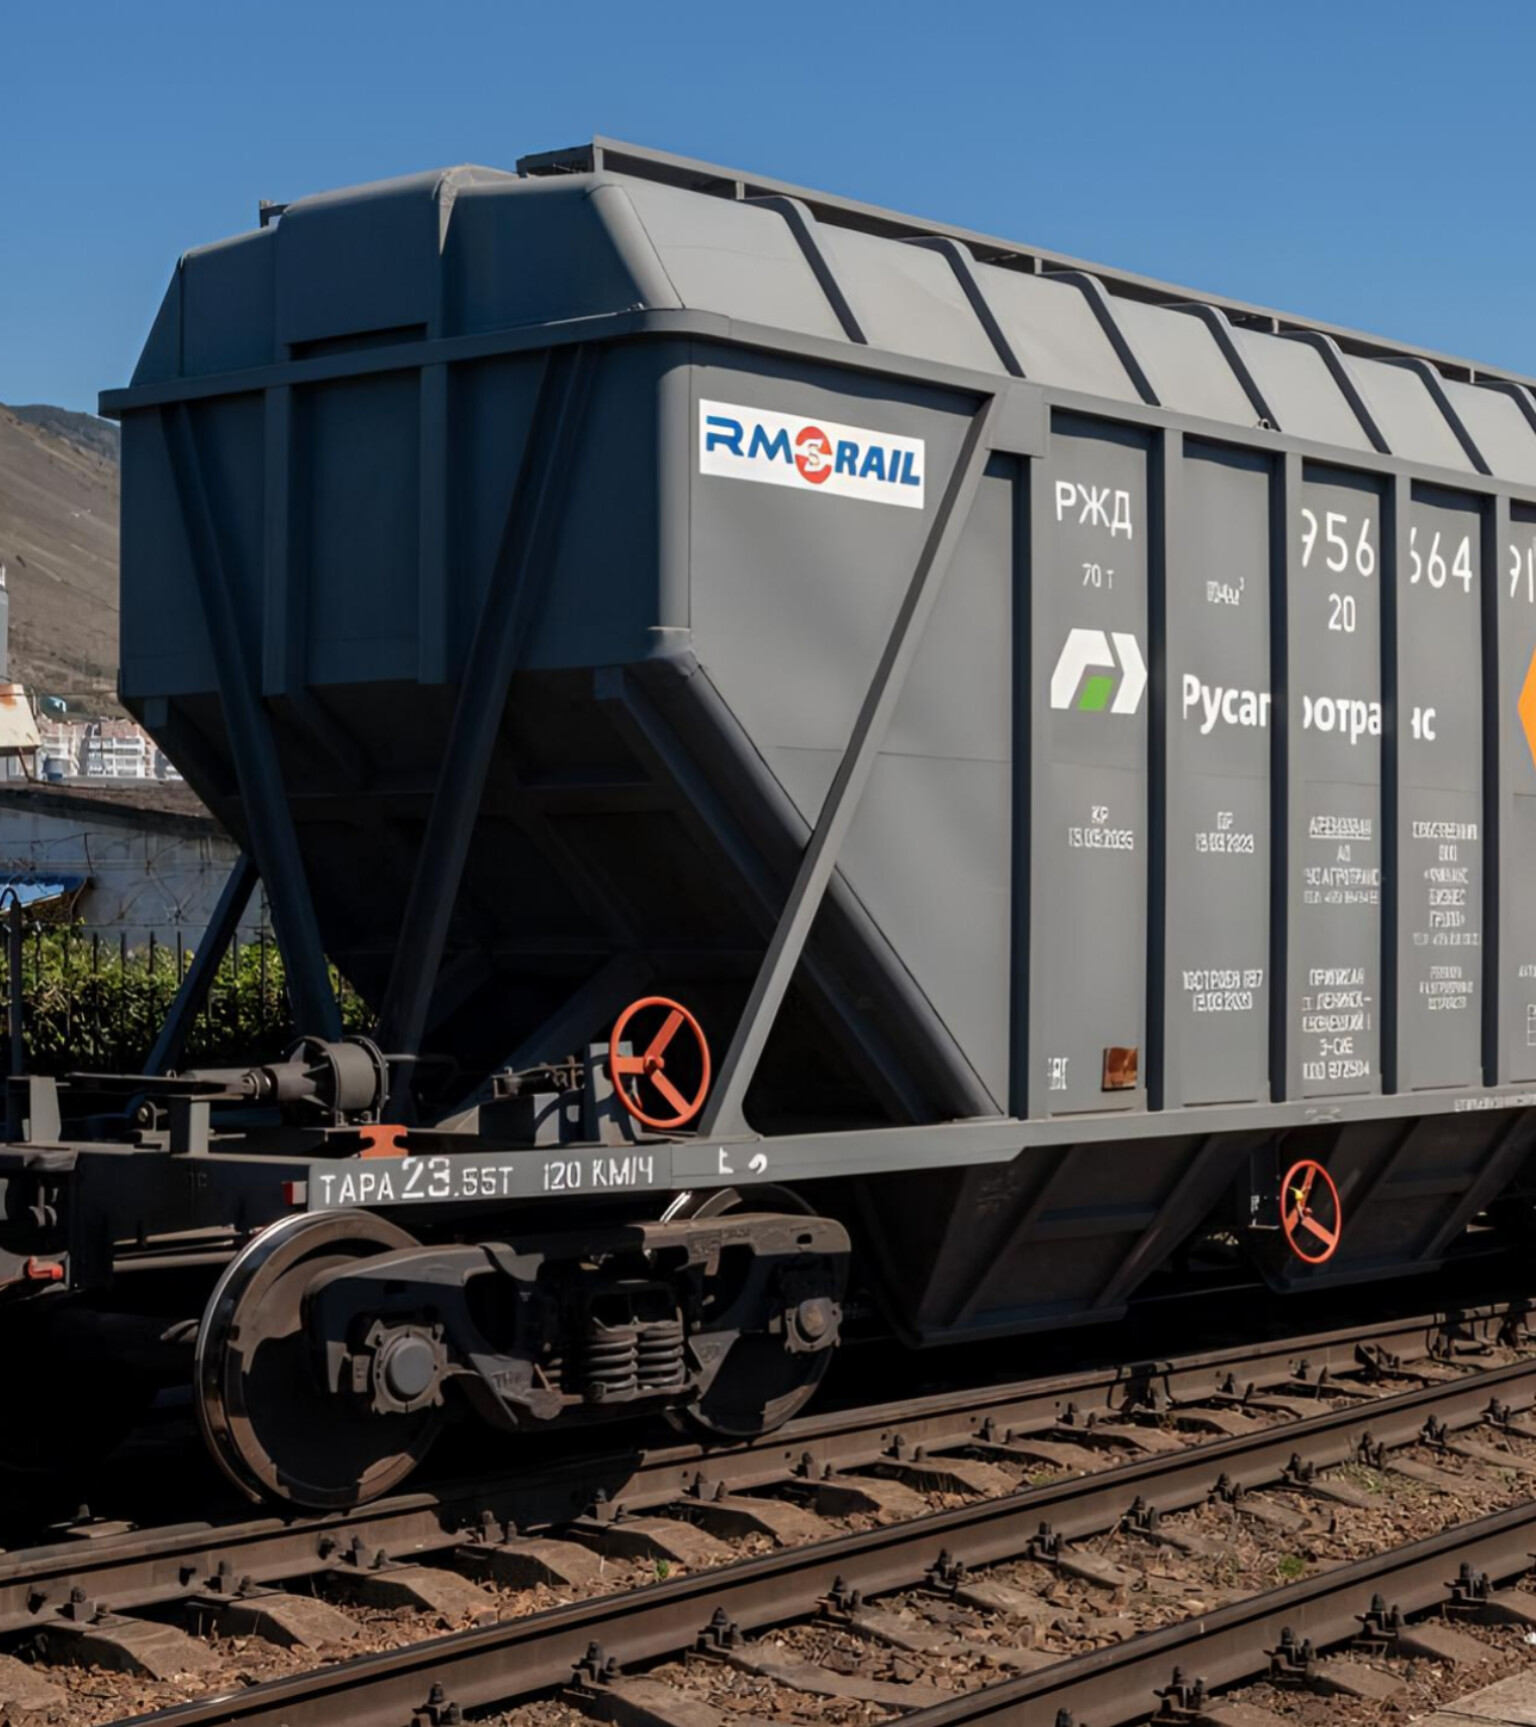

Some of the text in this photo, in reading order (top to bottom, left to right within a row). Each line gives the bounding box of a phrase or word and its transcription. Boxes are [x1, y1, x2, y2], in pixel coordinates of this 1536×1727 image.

[1055, 480, 1133, 540] РЖД
[1082, 562, 1102, 588] 70
[1328, 593, 1356, 633] 20
[319, 1171, 396, 1204] ТАРА
[543, 1160, 582, 1190] 120
